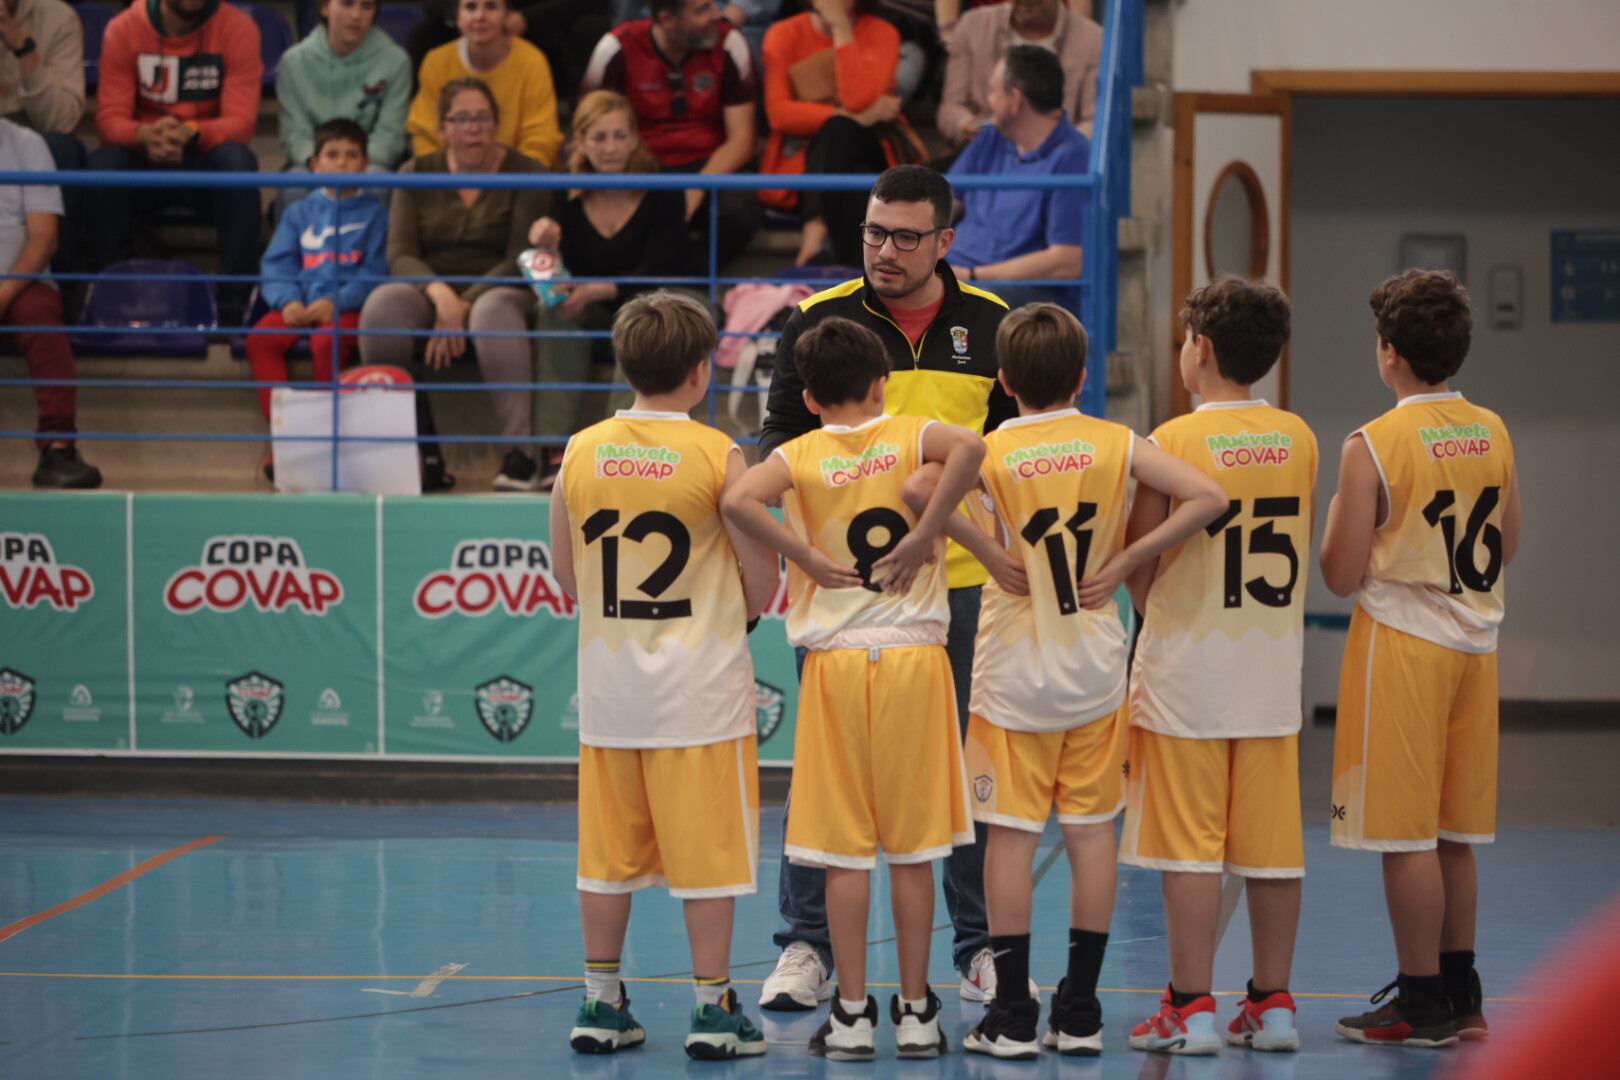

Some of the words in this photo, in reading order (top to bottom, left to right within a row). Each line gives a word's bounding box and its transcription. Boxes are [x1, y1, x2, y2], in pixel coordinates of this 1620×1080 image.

[1221, 447, 1289, 467] COVAP
[1432, 439, 1490, 459] COVAP
[603, 459, 673, 479] COVAP
[831, 453, 897, 485] COVAP
[1018, 453, 1093, 478] COVAP
[0, 537, 51, 564] PA
[207, 541, 298, 566] COPA
[1205, 497, 1300, 609] 15
[1422, 486, 1502, 594] 16
[457, 544, 549, 569] COPA
[581, 508, 692, 620] 12
[1021, 502, 1097, 615] 11
[0, 564, 92, 608] VAP
[167, 569, 340, 611] COVAP
